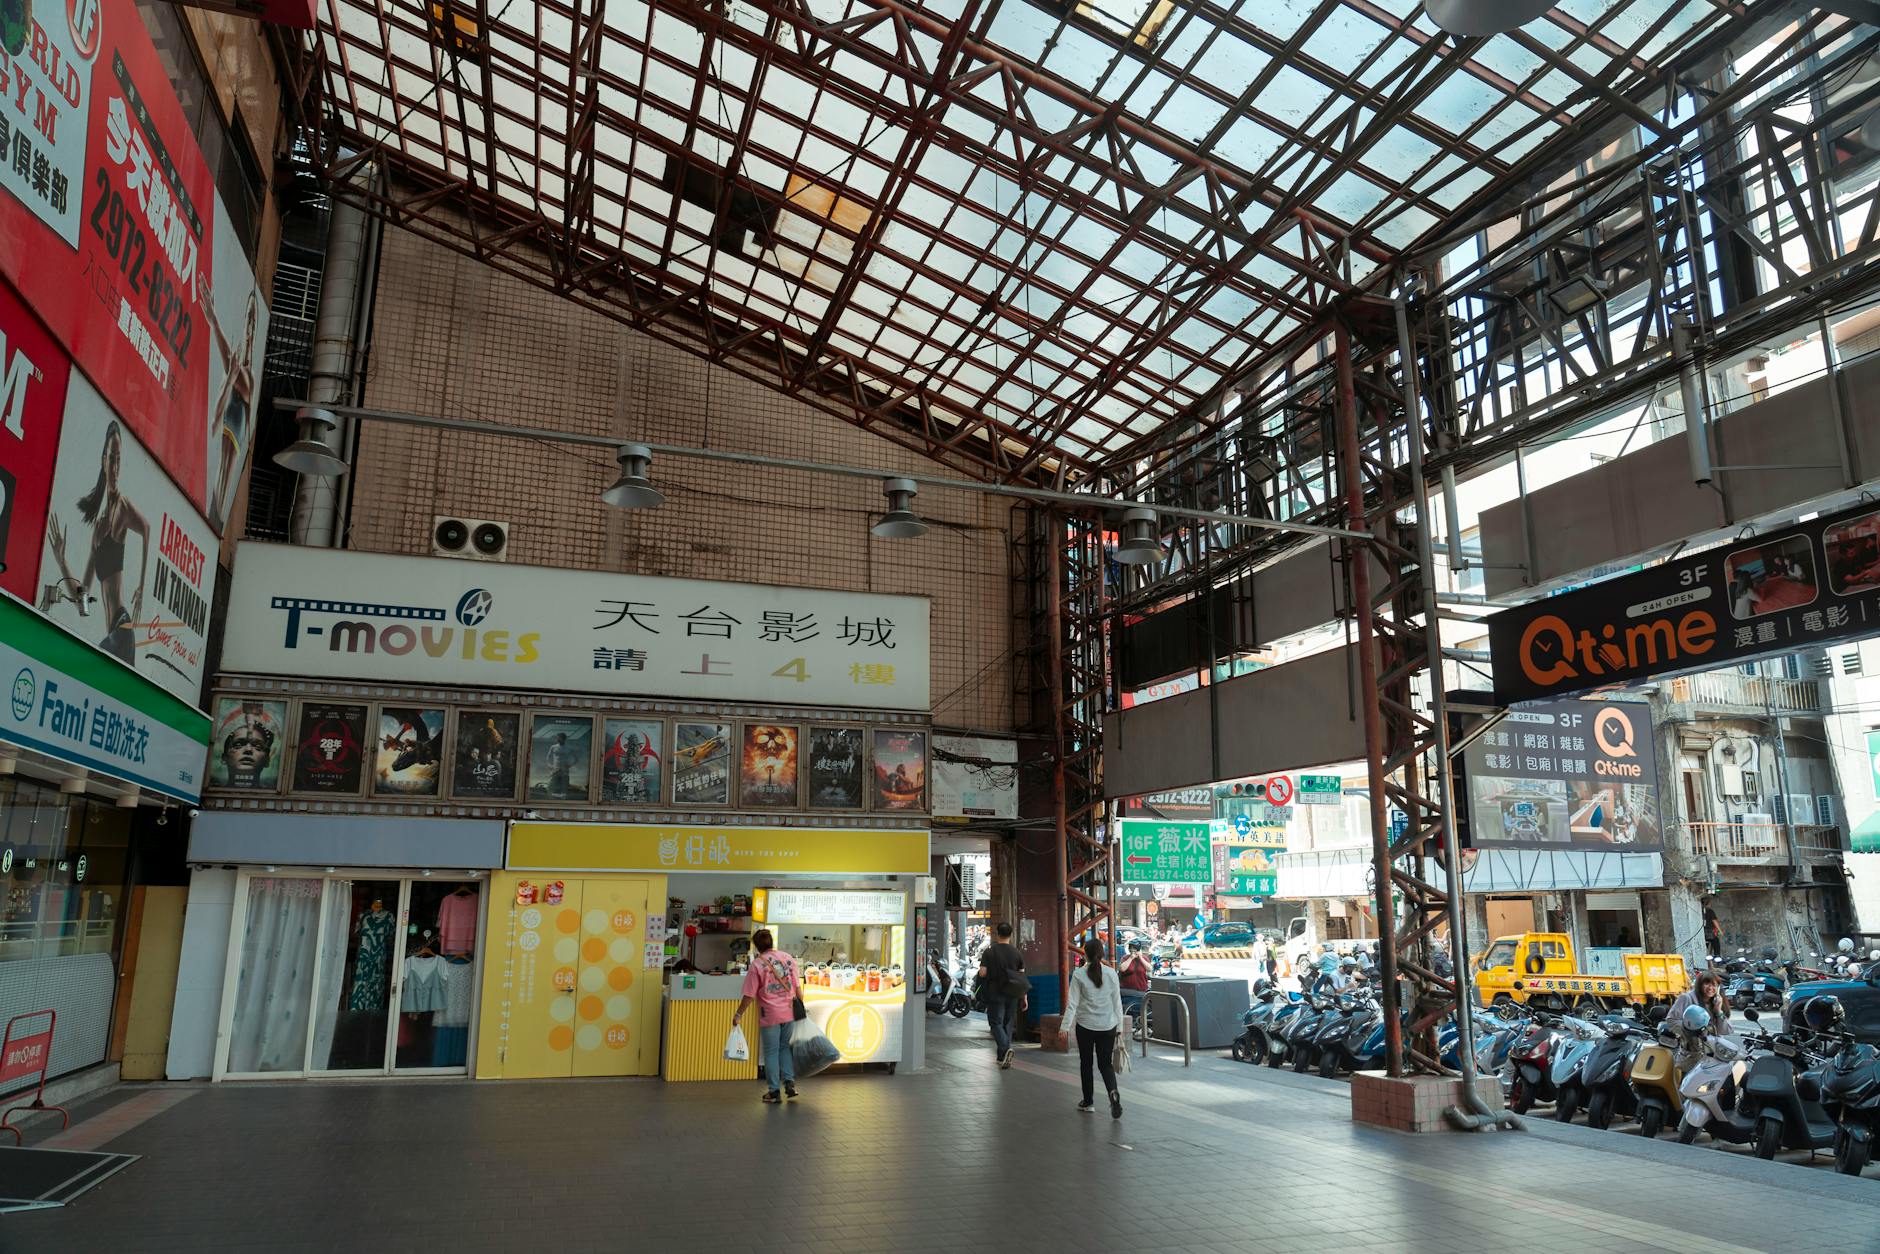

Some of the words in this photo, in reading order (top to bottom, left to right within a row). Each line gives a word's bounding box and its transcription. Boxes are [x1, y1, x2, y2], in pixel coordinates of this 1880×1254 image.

[91, 167, 193, 369] 2972-8222
[159, 512, 206, 590] LARGEST
[1679, 565, 1708, 586] 3F
[153, 557, 167, 605] IN
[167, 571, 207, 638] TAIWAN
[1642, 600, 1662, 612] 24H
[1667, 593, 1695, 606] OPEN
[148, 615, 171, 648] Come
[593, 599, 897, 649] 天台影城
[1734, 622, 1777, 648] 漫畫
[1802, 604, 1849, 632] 電影
[1519, 610, 1717, 686] Qtime
[1148, 682, 1181, 697] GYM
[39, 679, 89, 742] Fami
[1518, 713, 1540, 721] OPEN
[1560, 713, 1582, 728] 3F
[90, 705, 149, 765] 自助洗衣
[1523, 733, 1549, 749] 網路
[1560, 736, 1585, 751] 雜誌
[1484, 754, 1511, 769] 電影
[1526, 757, 1551, 772] 包廂
[1561, 759, 1587, 774] 閱讀
[1594, 759, 1642, 777] Qtime
[1126, 835, 1153, 850] 16F
[1157, 827, 1206, 854] 薇米
[1156, 855, 1180, 868] 住宿
[1185, 855, 1208, 868] 休息
[1546, 980, 1621, 992] 免費道路救援
